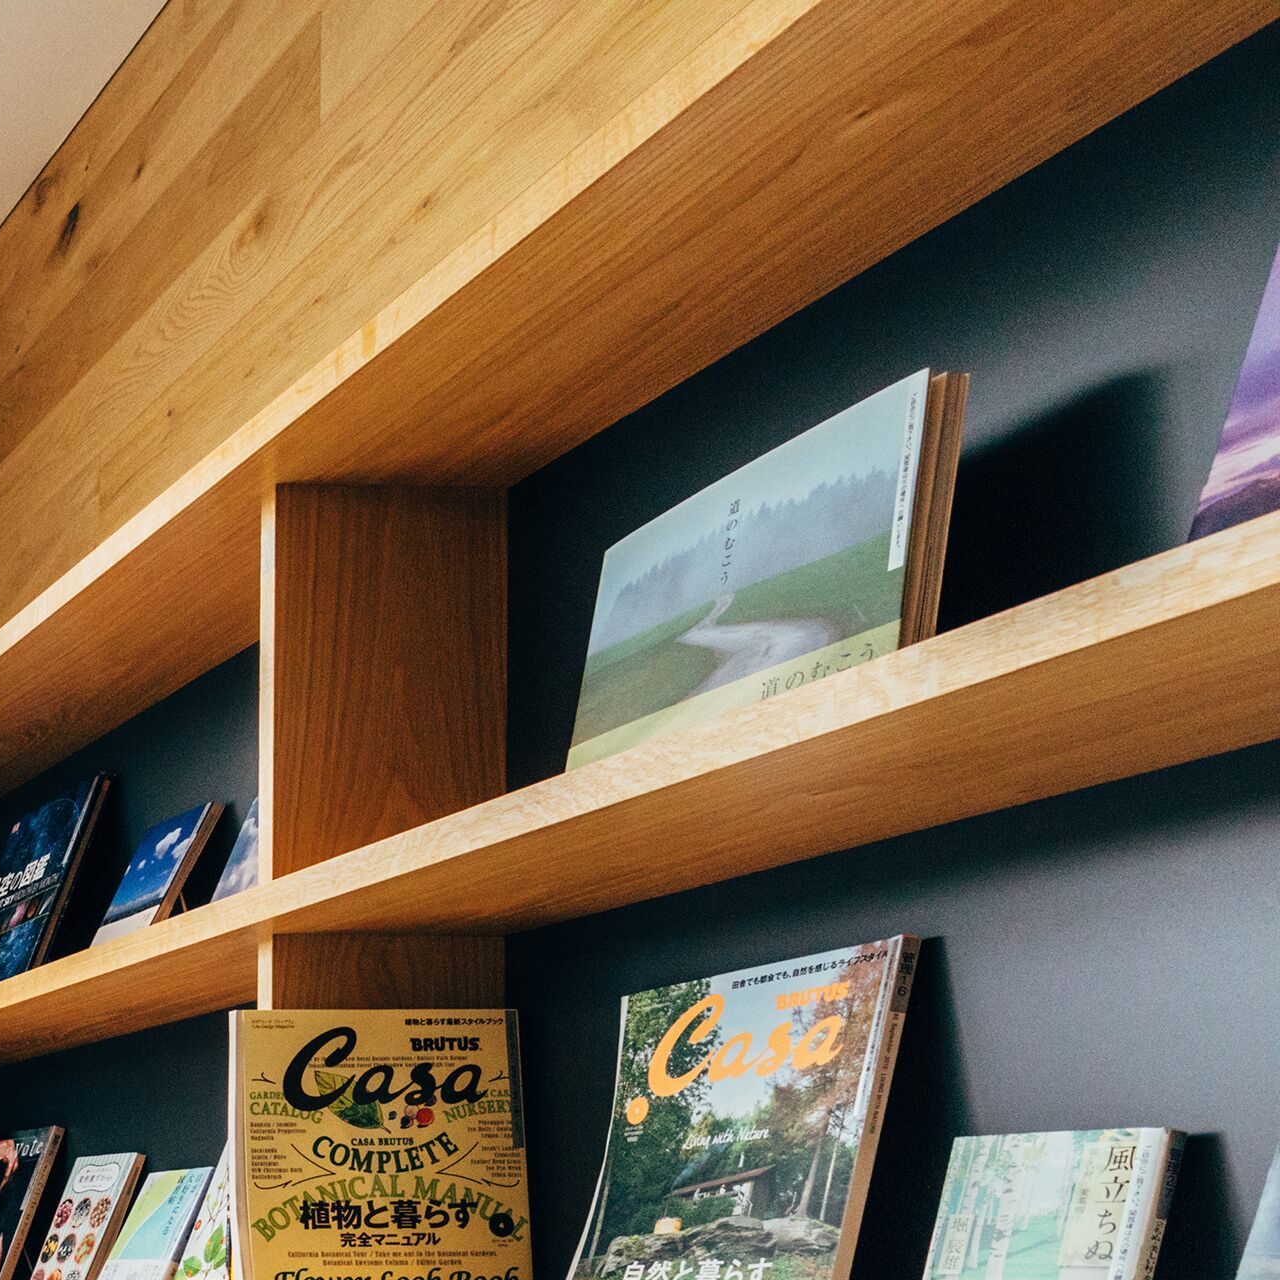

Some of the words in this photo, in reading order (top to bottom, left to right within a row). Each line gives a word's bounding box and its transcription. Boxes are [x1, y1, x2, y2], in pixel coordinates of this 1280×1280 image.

[720, 499, 741, 584] 道のむこう
[762, 643, 874, 700] 道のむこう
[776, 981, 852, 1011] BRUTUS
[405, 1018, 505, 1027] 植物と暮らす最新スタイルブック
[410, 1037, 480, 1052] BRUTUS
[647, 993, 844, 1098] Casa
[282, 1026, 489, 1111] Casa
[249, 1101, 324, 1123] CATALOG
[351, 1138, 375, 1146] CASA
[378, 1138, 414, 1146] BRUTUS
[683, 1134, 711, 1150] Living
[712, 1128, 735, 1145] with
[737, 1125, 770, 1142] Nature
[312, 1132, 459, 1174] COMPLETE
[251, 1174, 406, 1242] BOTANICAL
[299, 1200, 479, 1230] 植物と暮らす
[1084, 1145, 1137, 1261] 風立ちぬ
[340, 1232, 441, 1248] 完全マニュアル
